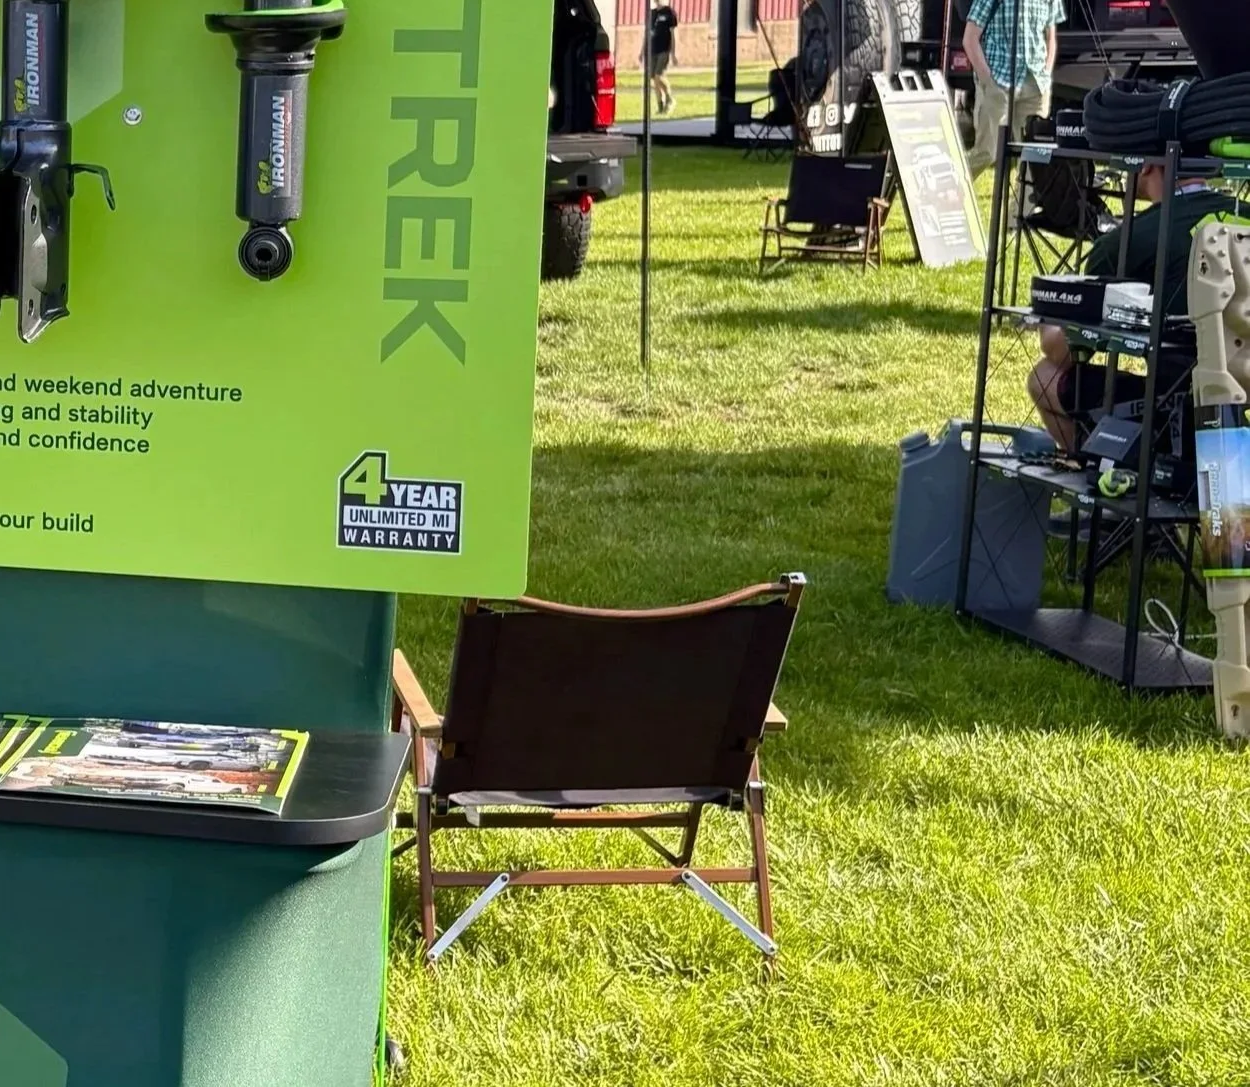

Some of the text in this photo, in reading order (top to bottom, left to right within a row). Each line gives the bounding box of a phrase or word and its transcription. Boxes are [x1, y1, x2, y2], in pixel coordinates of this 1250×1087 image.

[25, 12, 40, 105] IRONMAN
[271, 95, 285, 187] IRONMAN
[23, 375, 122, 397] weekend
[129, 379, 243, 402] adventure
[21, 402, 61, 422] and
[68, 404, 154, 430] stability
[28, 430, 150, 454] confidence
[343, 456, 456, 509] 4 YEAR
[42, 511, 94, 533] build
[349, 508, 450, 528] UNLIMITED MI
[343, 528, 455, 549] WARRANTY
